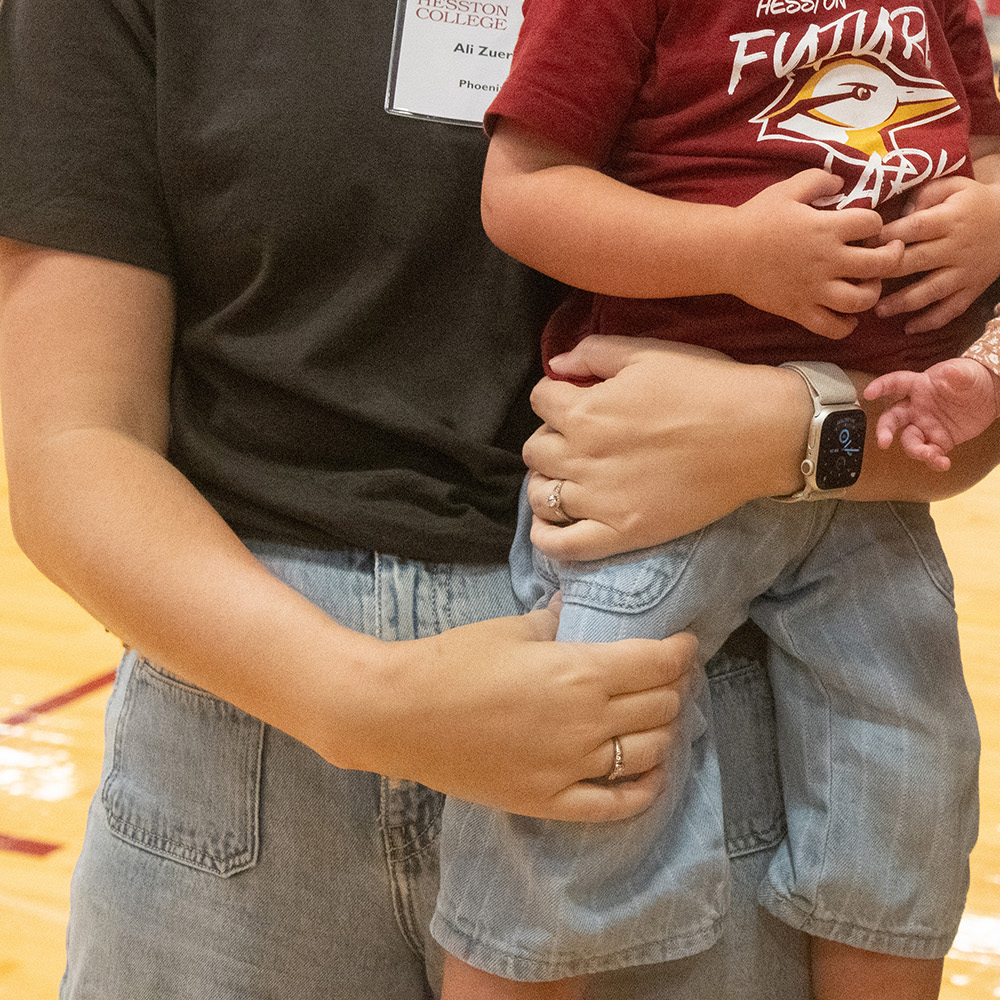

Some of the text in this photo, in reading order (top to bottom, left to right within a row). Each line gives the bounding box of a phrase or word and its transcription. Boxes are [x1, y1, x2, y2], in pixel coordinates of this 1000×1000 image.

[416, 7, 507, 30] COLLEGE
[453, 43, 474, 55] Ali
[459, 79, 501, 92] Phoeni
